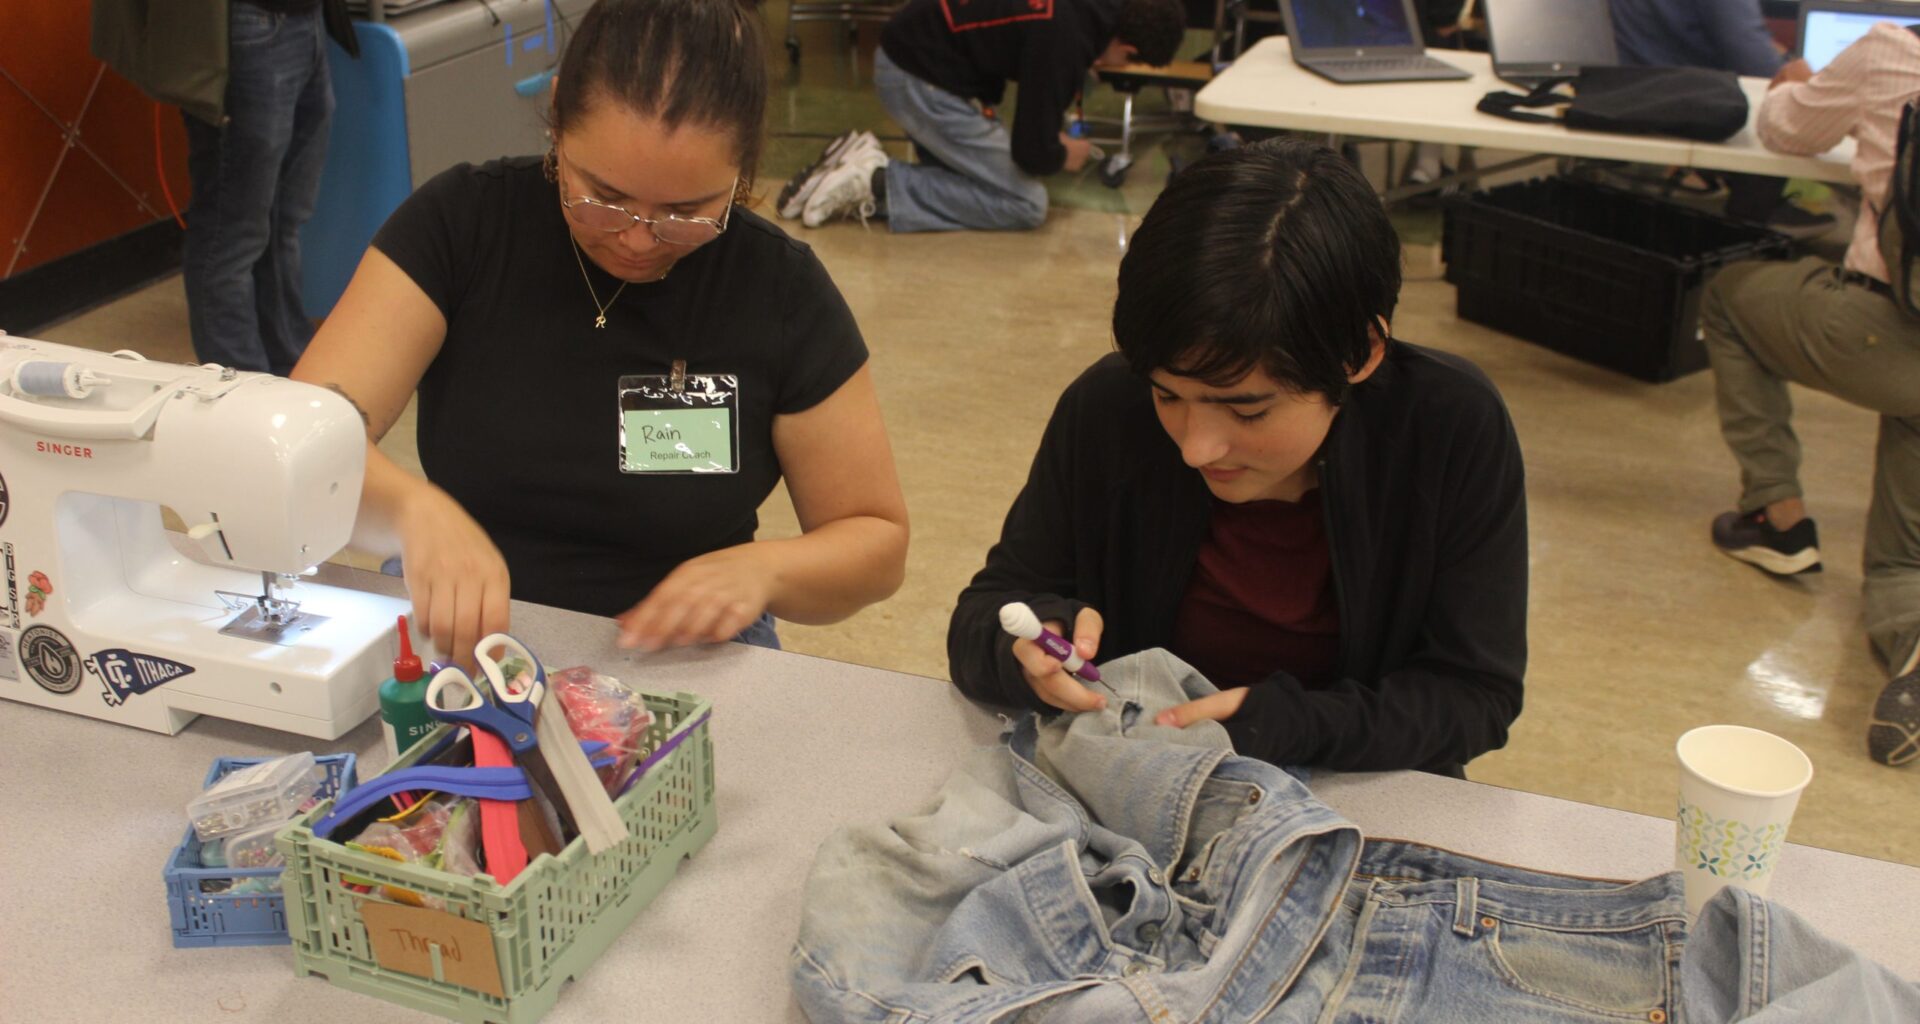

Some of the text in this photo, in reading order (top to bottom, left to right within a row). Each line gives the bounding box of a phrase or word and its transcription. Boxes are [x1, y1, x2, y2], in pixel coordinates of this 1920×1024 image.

[642, 425, 681, 444] Rain
[36, 441, 92, 458] SINGER
[650, 451, 679, 460] Repair
[133, 657, 183, 685] ITHACA
